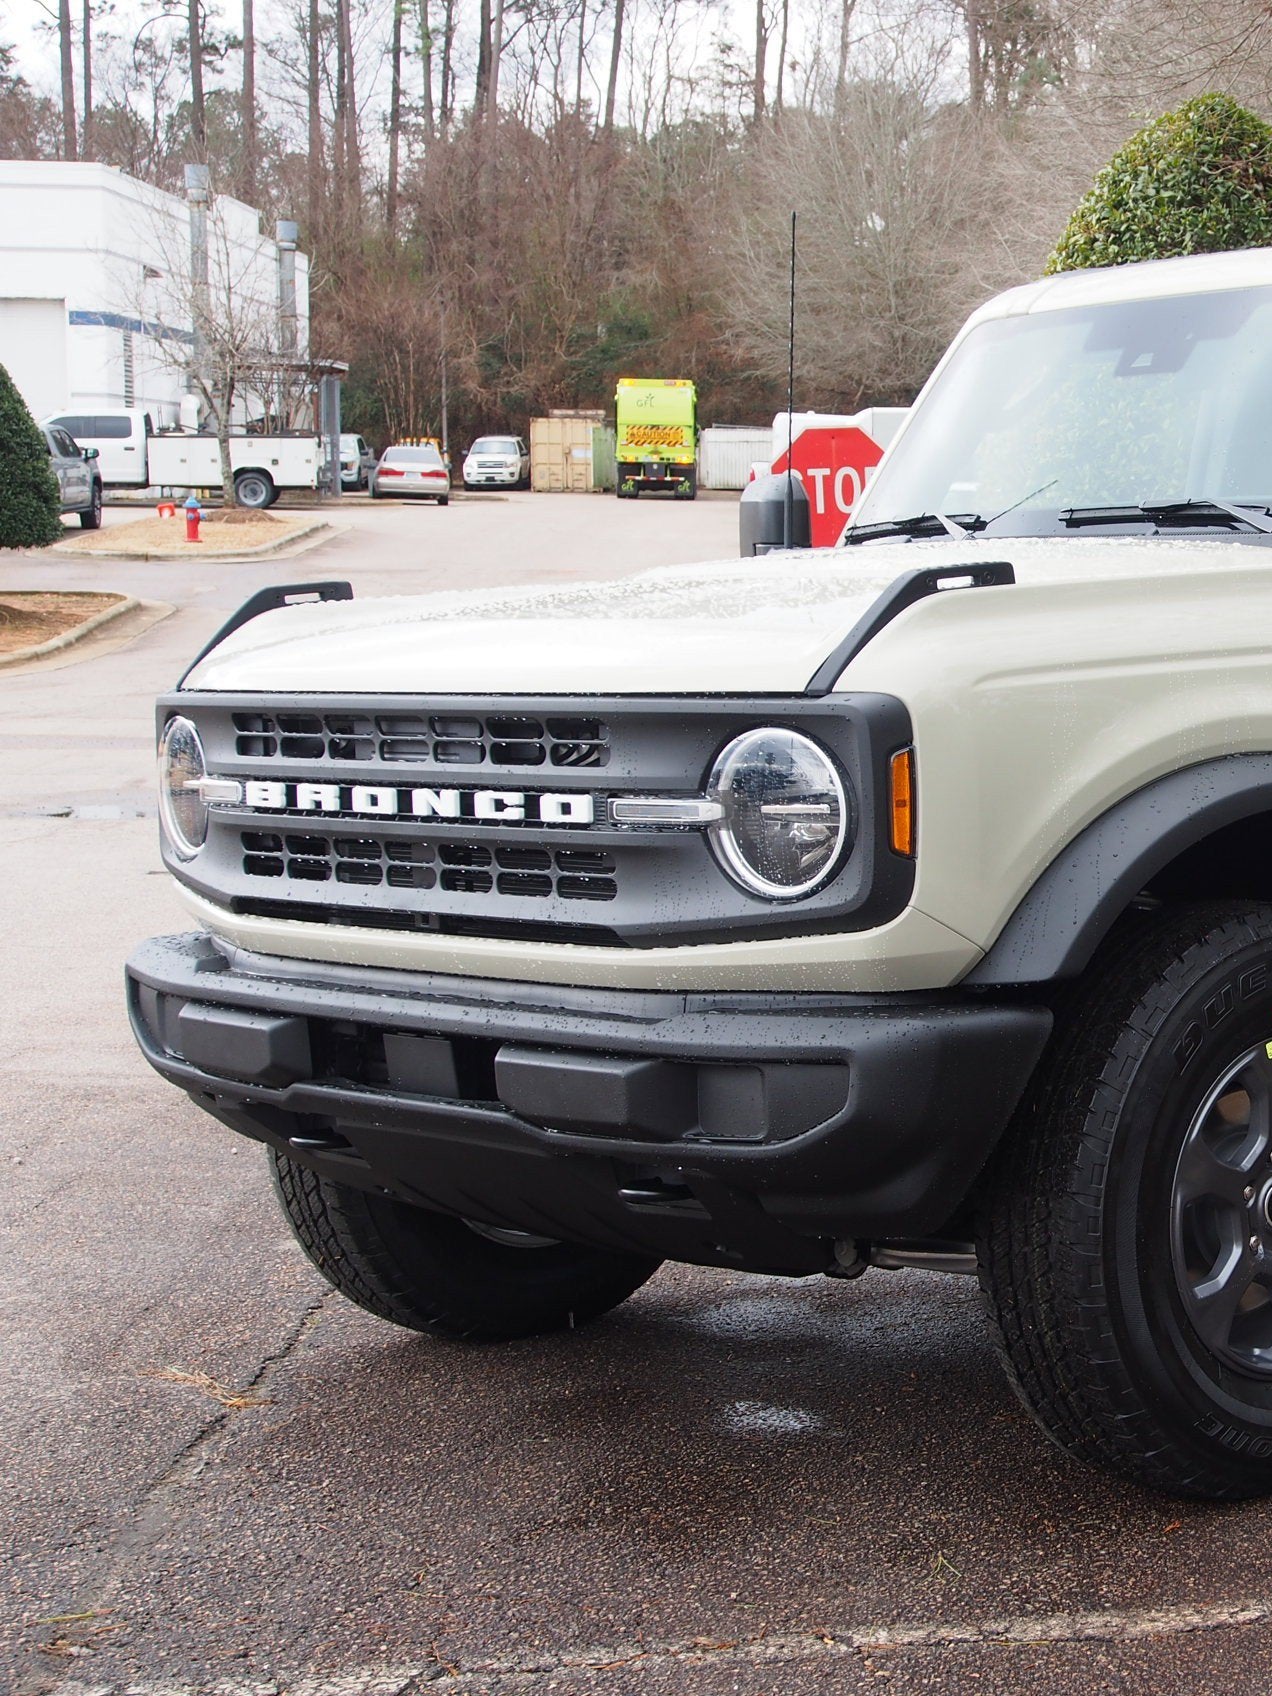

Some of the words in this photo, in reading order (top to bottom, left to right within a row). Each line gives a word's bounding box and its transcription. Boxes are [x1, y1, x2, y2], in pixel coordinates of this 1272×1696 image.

[636, 431, 671, 439] CAUTION
[783, 466, 877, 515] TO
[245, 781, 594, 824] BRONCO
